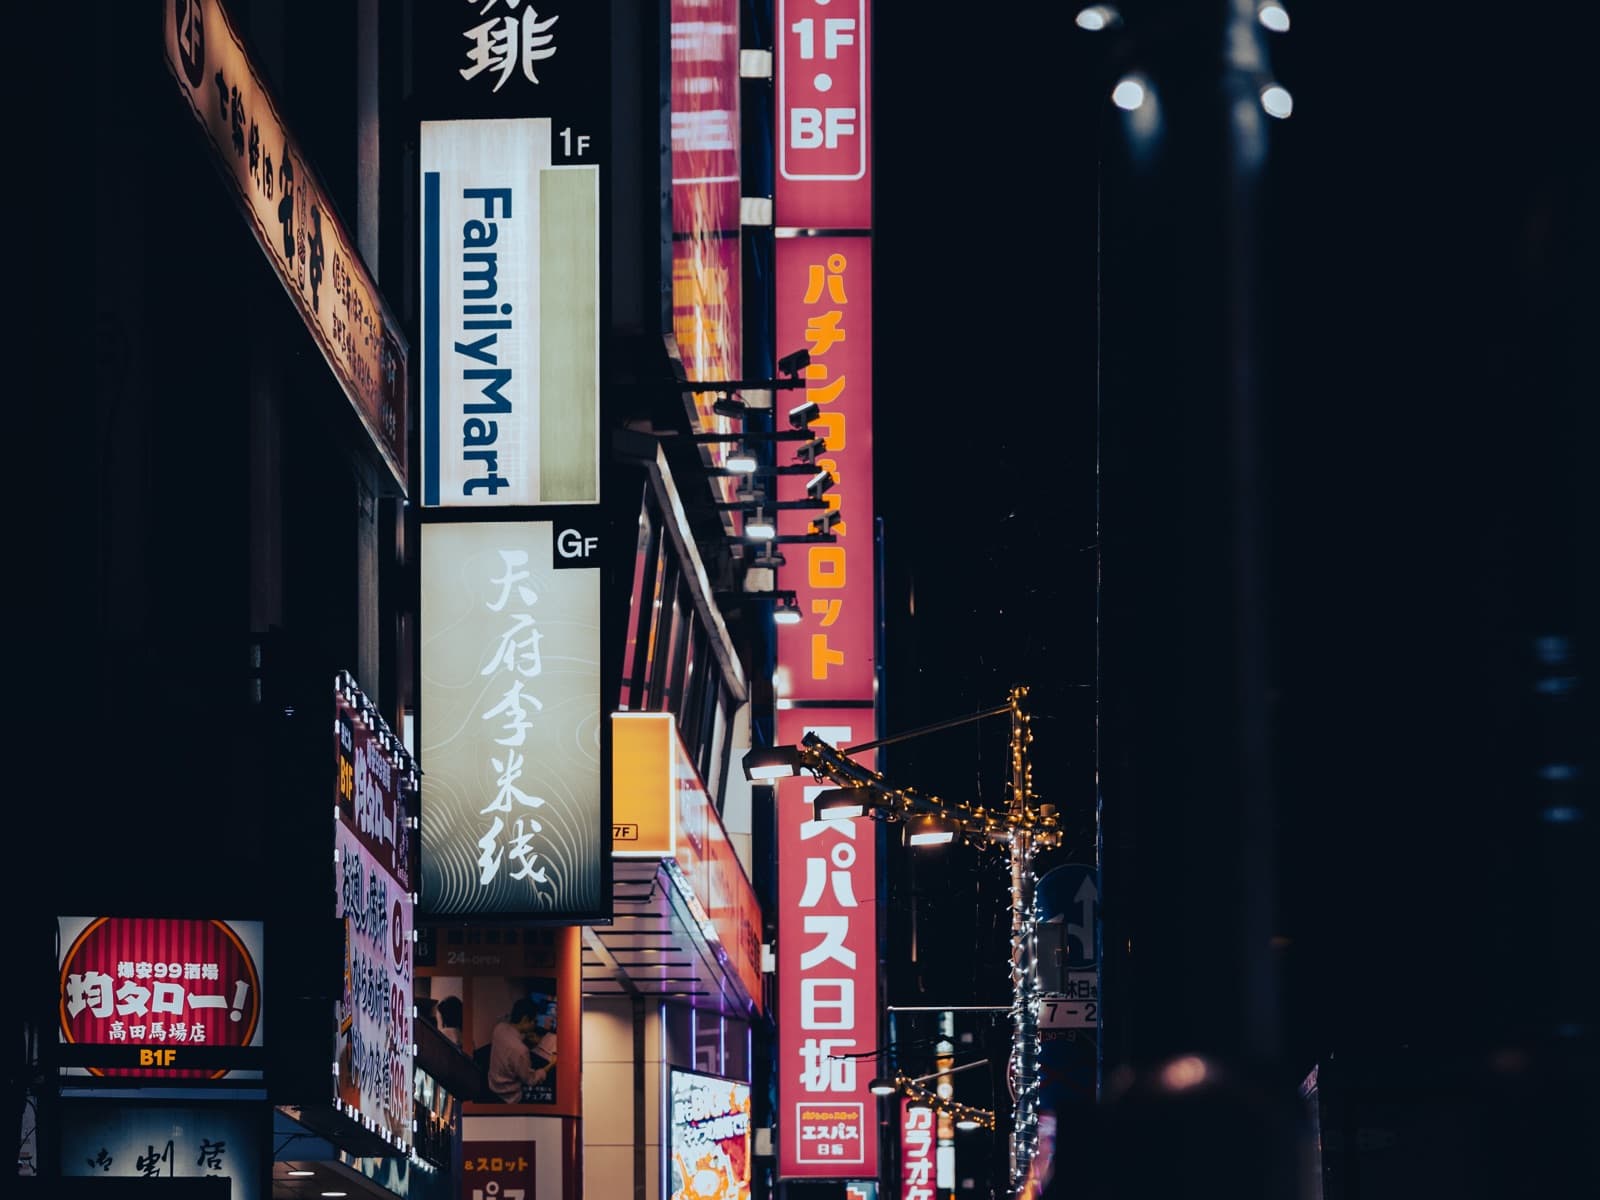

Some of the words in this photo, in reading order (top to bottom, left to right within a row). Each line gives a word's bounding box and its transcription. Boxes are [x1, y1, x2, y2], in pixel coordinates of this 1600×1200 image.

[459, 0, 559, 93] 琲
[791, 18, 856, 59] 1F
[559, 127, 590, 156] 1F
[790, 107, 857, 149] BF
[455, 187, 513, 496] FamilyMart
[557, 529, 599, 558] GF
[340, 755, 353, 800] B1F
[614, 827, 630, 837] 7F
[108, 1021, 207, 1042] 高田馬場店
[140, 1049, 176, 1066] B1F
[802, 1122, 858, 1140] エスパス
